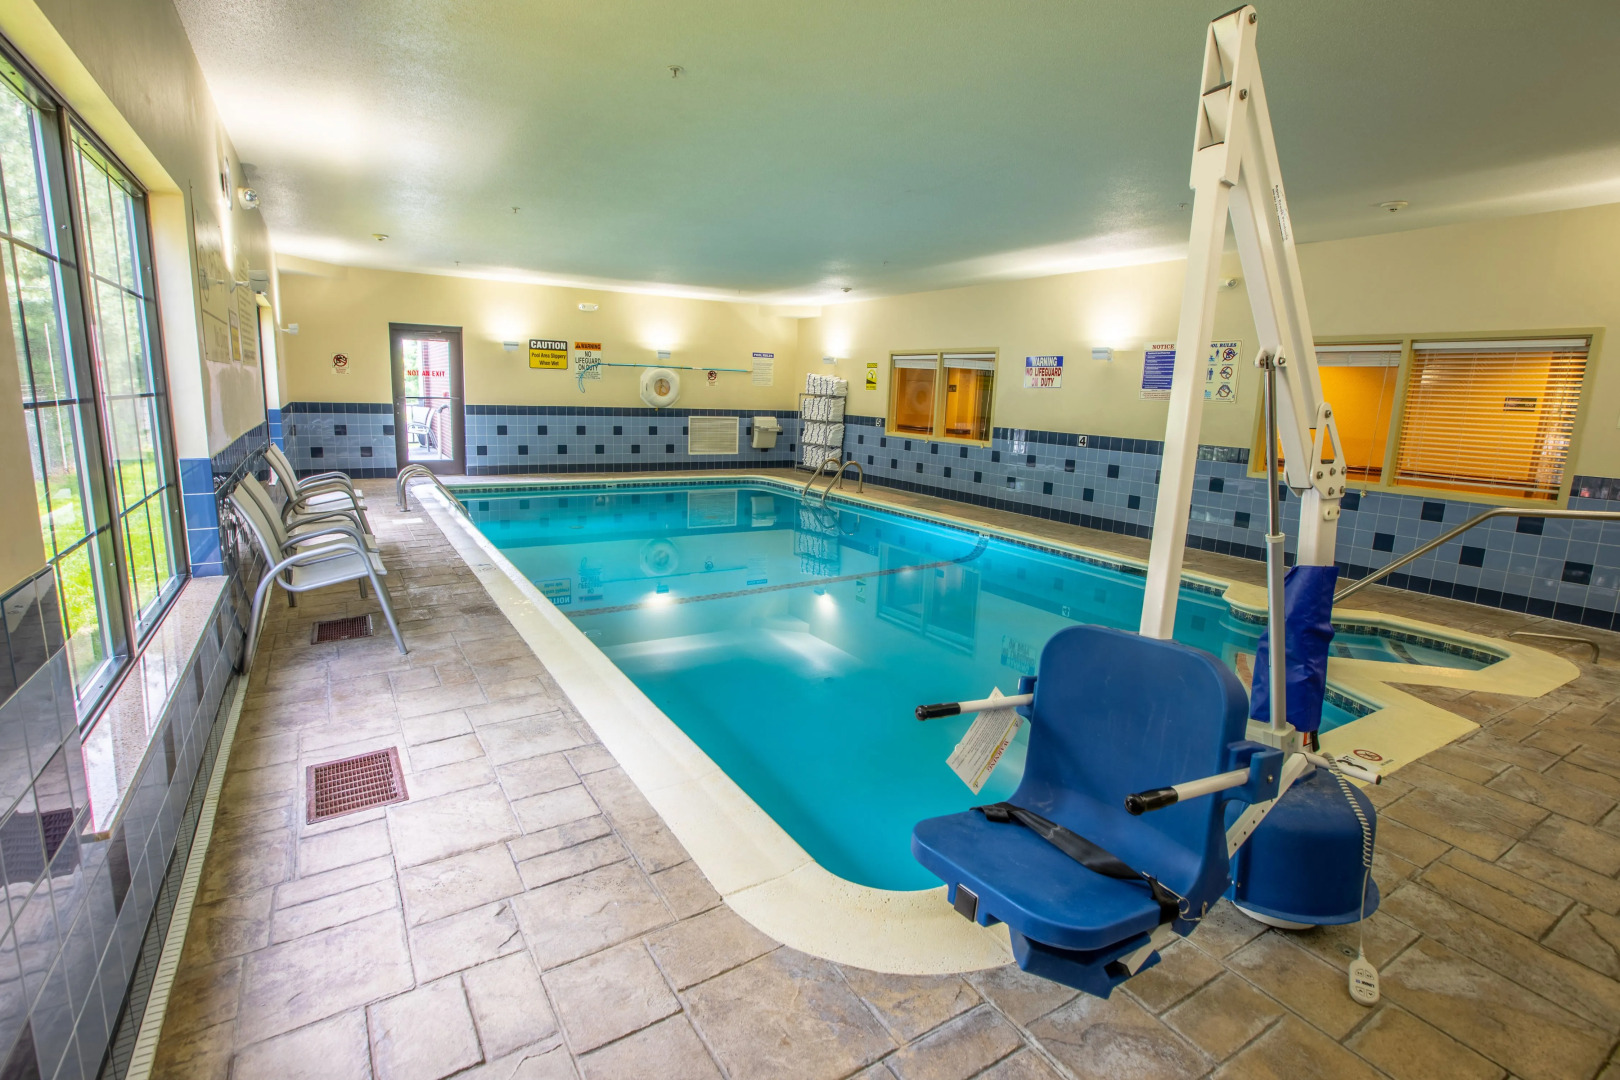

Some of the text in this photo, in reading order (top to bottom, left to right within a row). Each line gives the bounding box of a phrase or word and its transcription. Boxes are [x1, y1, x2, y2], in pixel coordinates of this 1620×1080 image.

[530, 340, 566, 350] CAUTION
[1031, 356, 1057, 367] WARNING
[1025, 367, 1062, 377] NO LIFEGUARD
[1031, 377, 1055, 387] ON DUTY
[1079, 436, 1086, 446] 4
[986, 739, 1009, 773] WARNING
